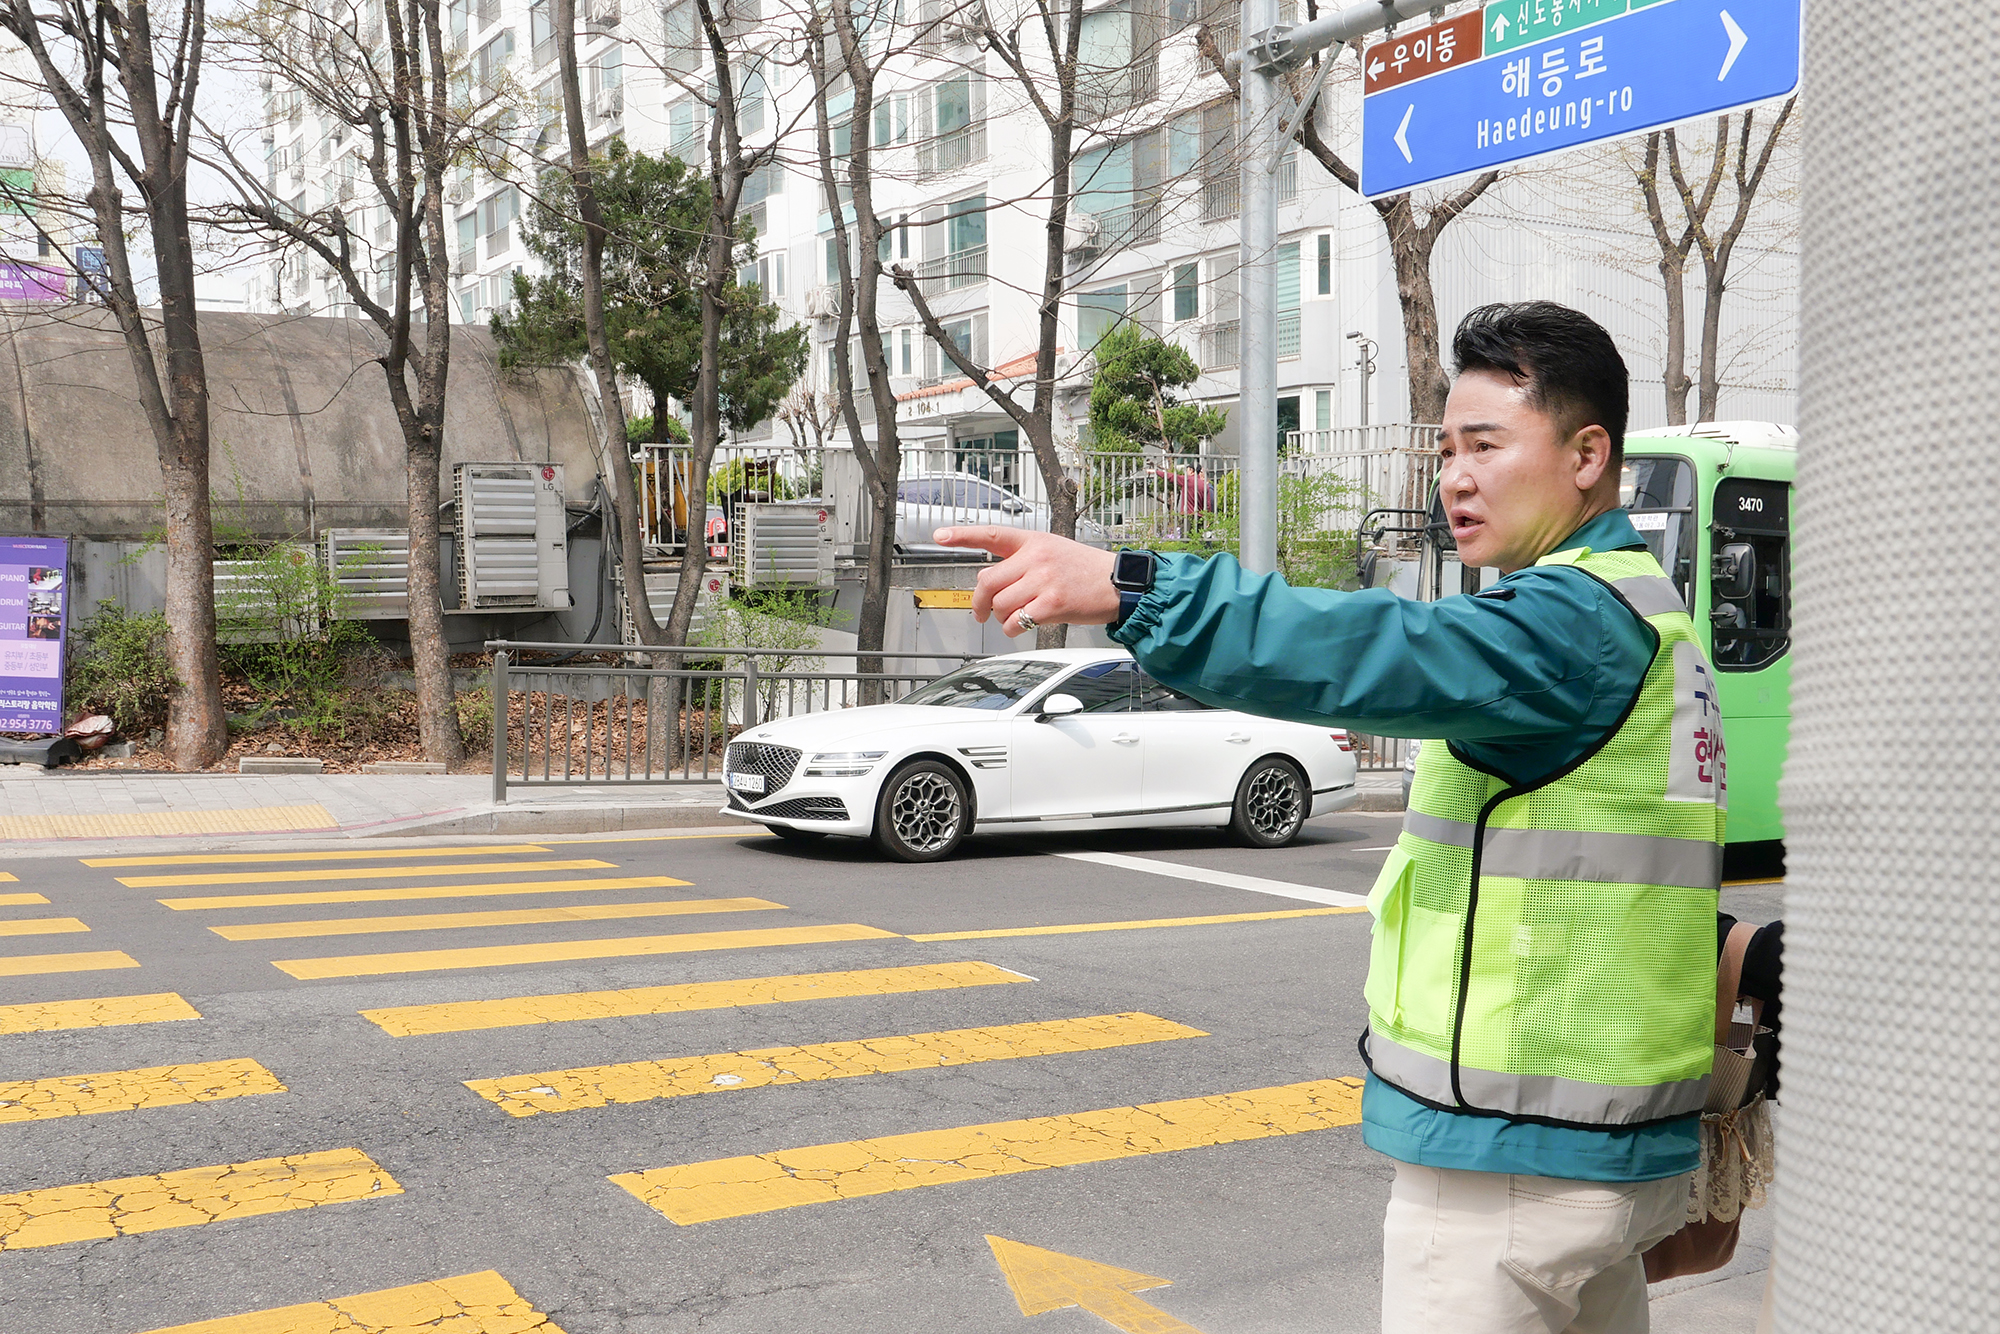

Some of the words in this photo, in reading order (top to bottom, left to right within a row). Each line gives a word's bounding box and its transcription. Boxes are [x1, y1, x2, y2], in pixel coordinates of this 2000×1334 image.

[1517, 0, 1616, 36] 신도봉
[1390, 27, 1457, 74] 우이동
[1501, 35, 1607, 98] 해등로
[1477, 86, 1633, 149] Haedeung-ro
[543, 483, 555, 491] LG
[1738, 497, 1763, 512] 3470
[0, 574, 26, 582] PIANO
[0, 598, 24, 606] DRUM
[0, 622, 26, 631] GUITAR
[4, 650, 24, 660] 유치부
[29, 651, 49, 661] 초등부
[4, 661, 23, 671] 중등부
[29, 662, 49, 672] 성인부
[31, 700, 58, 711] 음악학원
